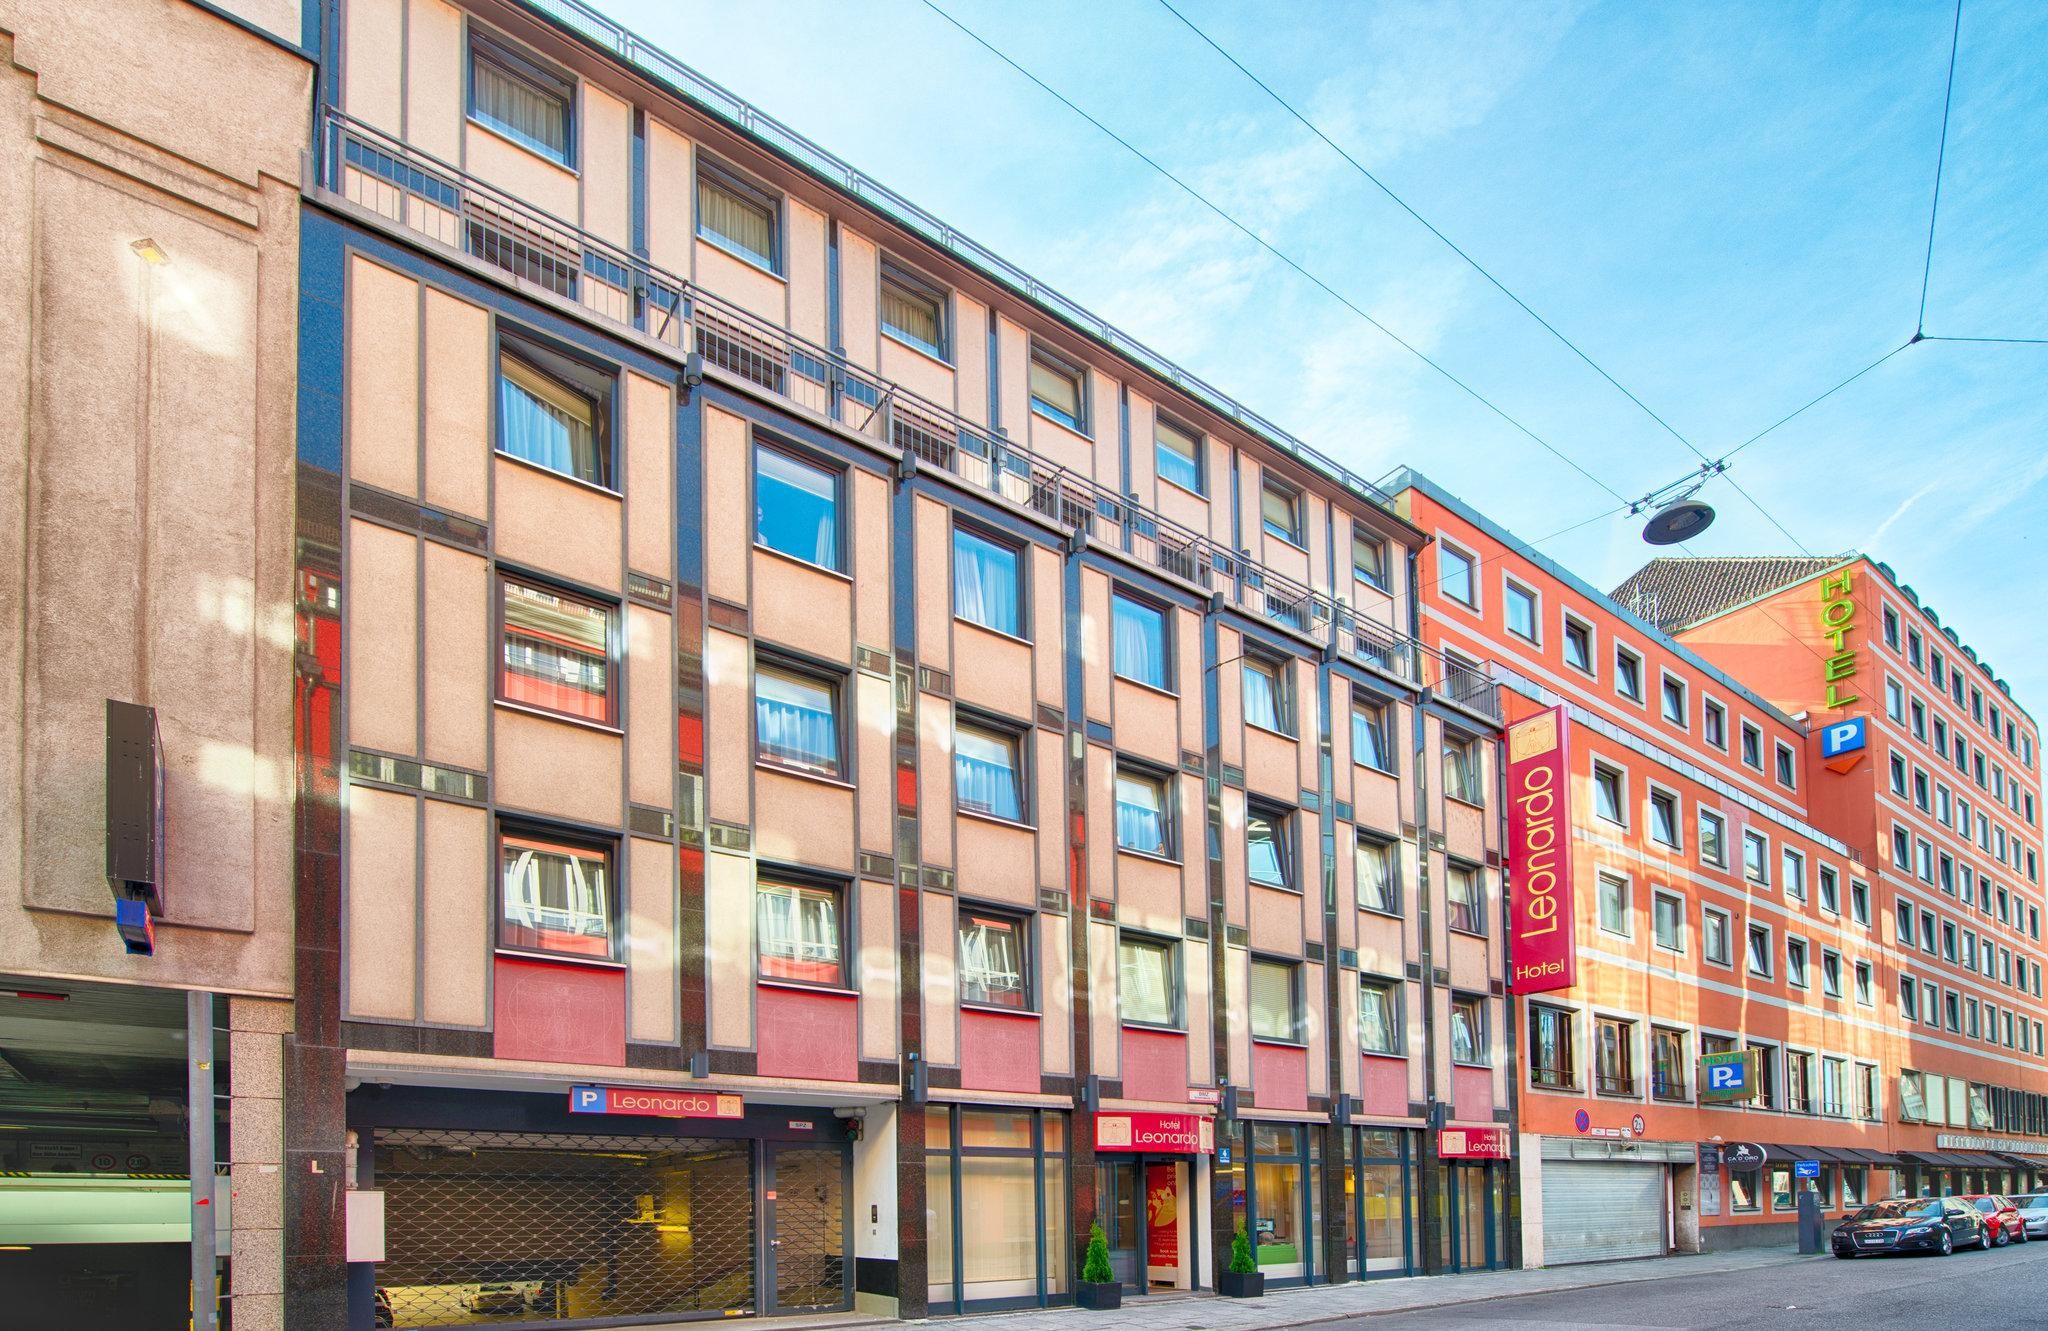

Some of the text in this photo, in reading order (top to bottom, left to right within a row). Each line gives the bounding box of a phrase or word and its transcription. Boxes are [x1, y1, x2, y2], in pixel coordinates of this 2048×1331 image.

[1820, 568, 1858, 709] HOTEL
[1830, 724, 1858, 753] P
[1516, 766, 1557, 938] Leonardo
[1516, 958, 1565, 981] Hotel
[1702, 1053, 1747, 1066] HOTEL
[1712, 1067, 1733, 1087] P
[582, 1091, 710, 1112] P Leonardo
[1159, 1120, 1181, 1130] Hotel
[1135, 1129, 1198, 1145] Leonardo
[1468, 1141, 1505, 1153] Leonardo
